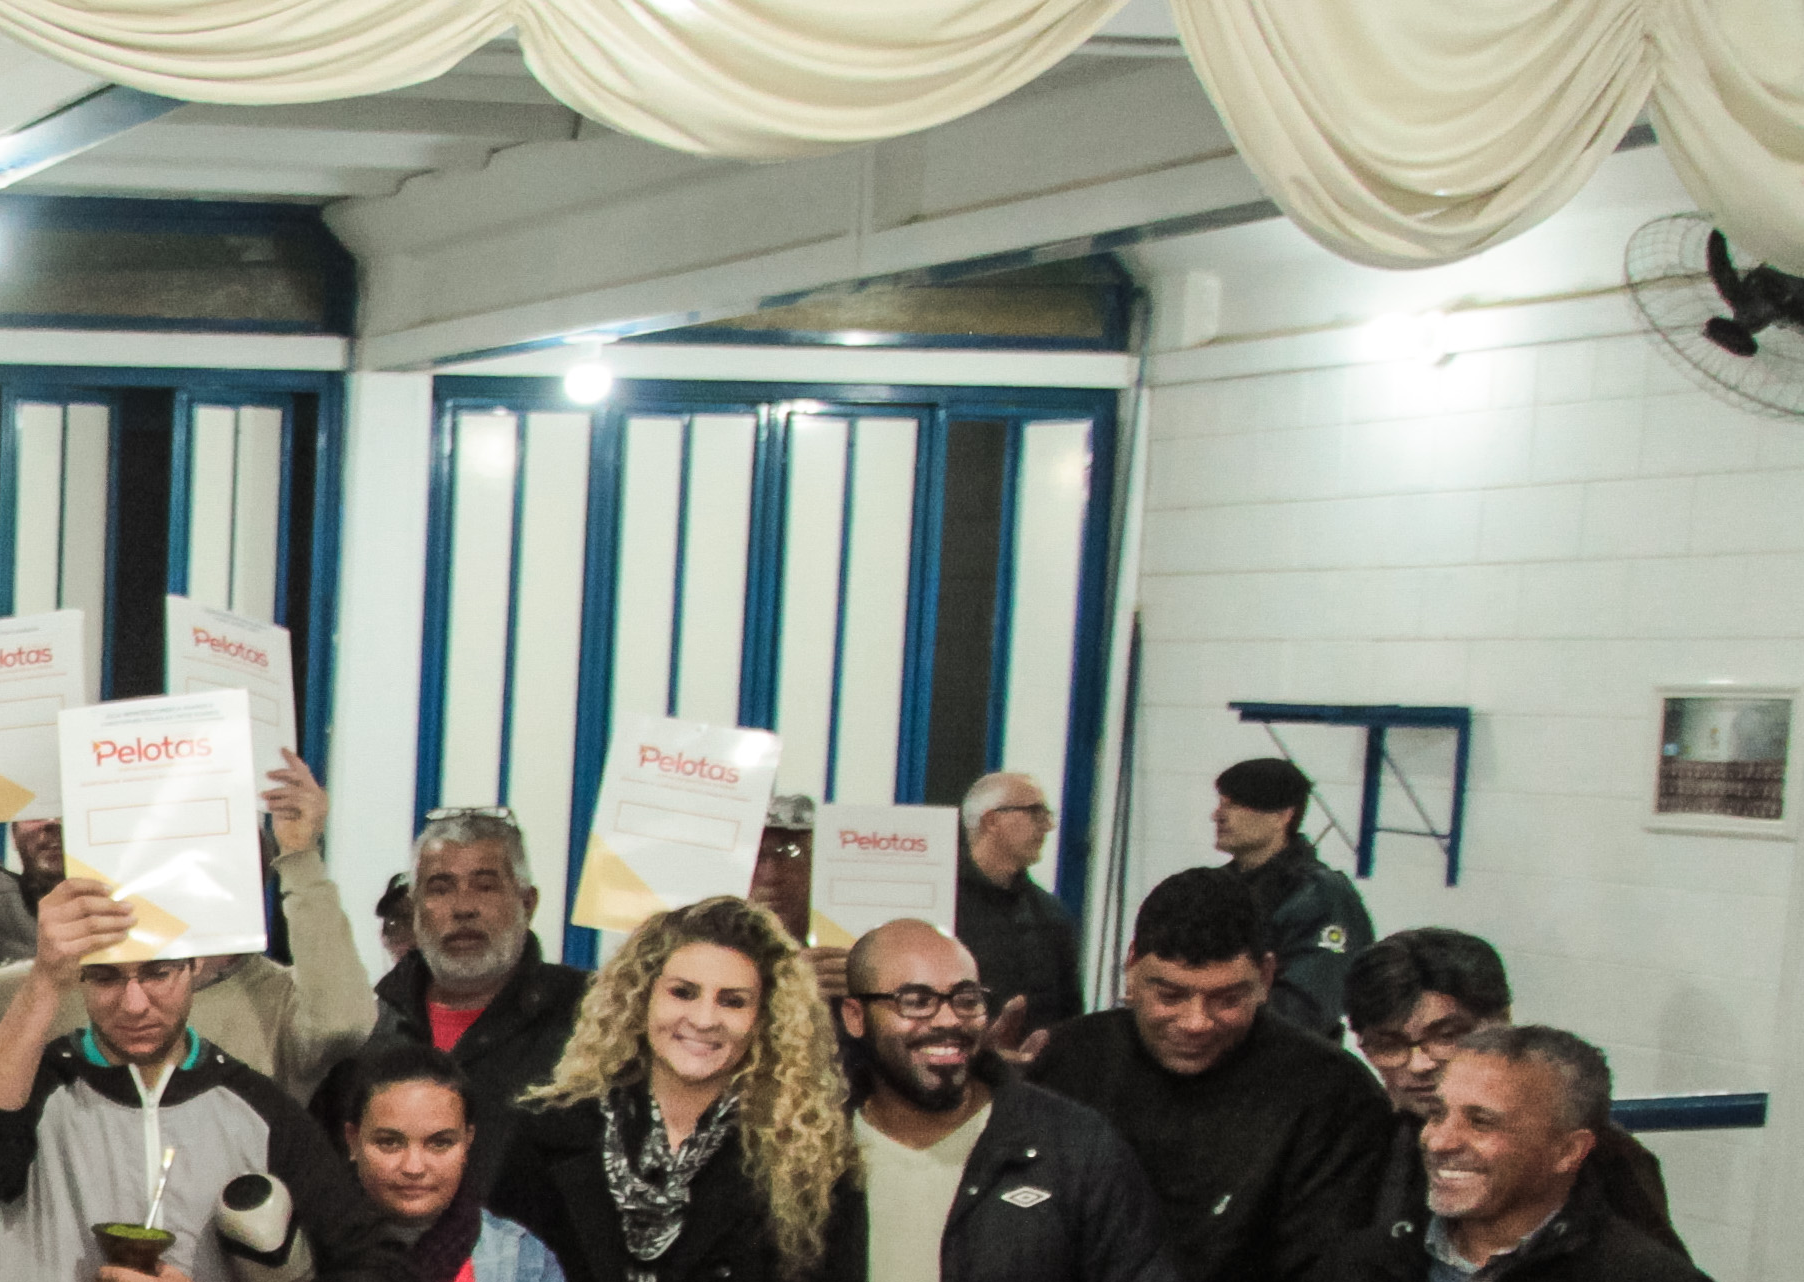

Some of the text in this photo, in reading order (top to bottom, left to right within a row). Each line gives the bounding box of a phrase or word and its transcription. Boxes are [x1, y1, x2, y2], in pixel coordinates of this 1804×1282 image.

[192, 626, 269, 667] Pelotas
[93, 736, 212, 766] Pelotas
[639, 745, 740, 784] Pelotas
[838, 829, 928, 853] Pelotas
